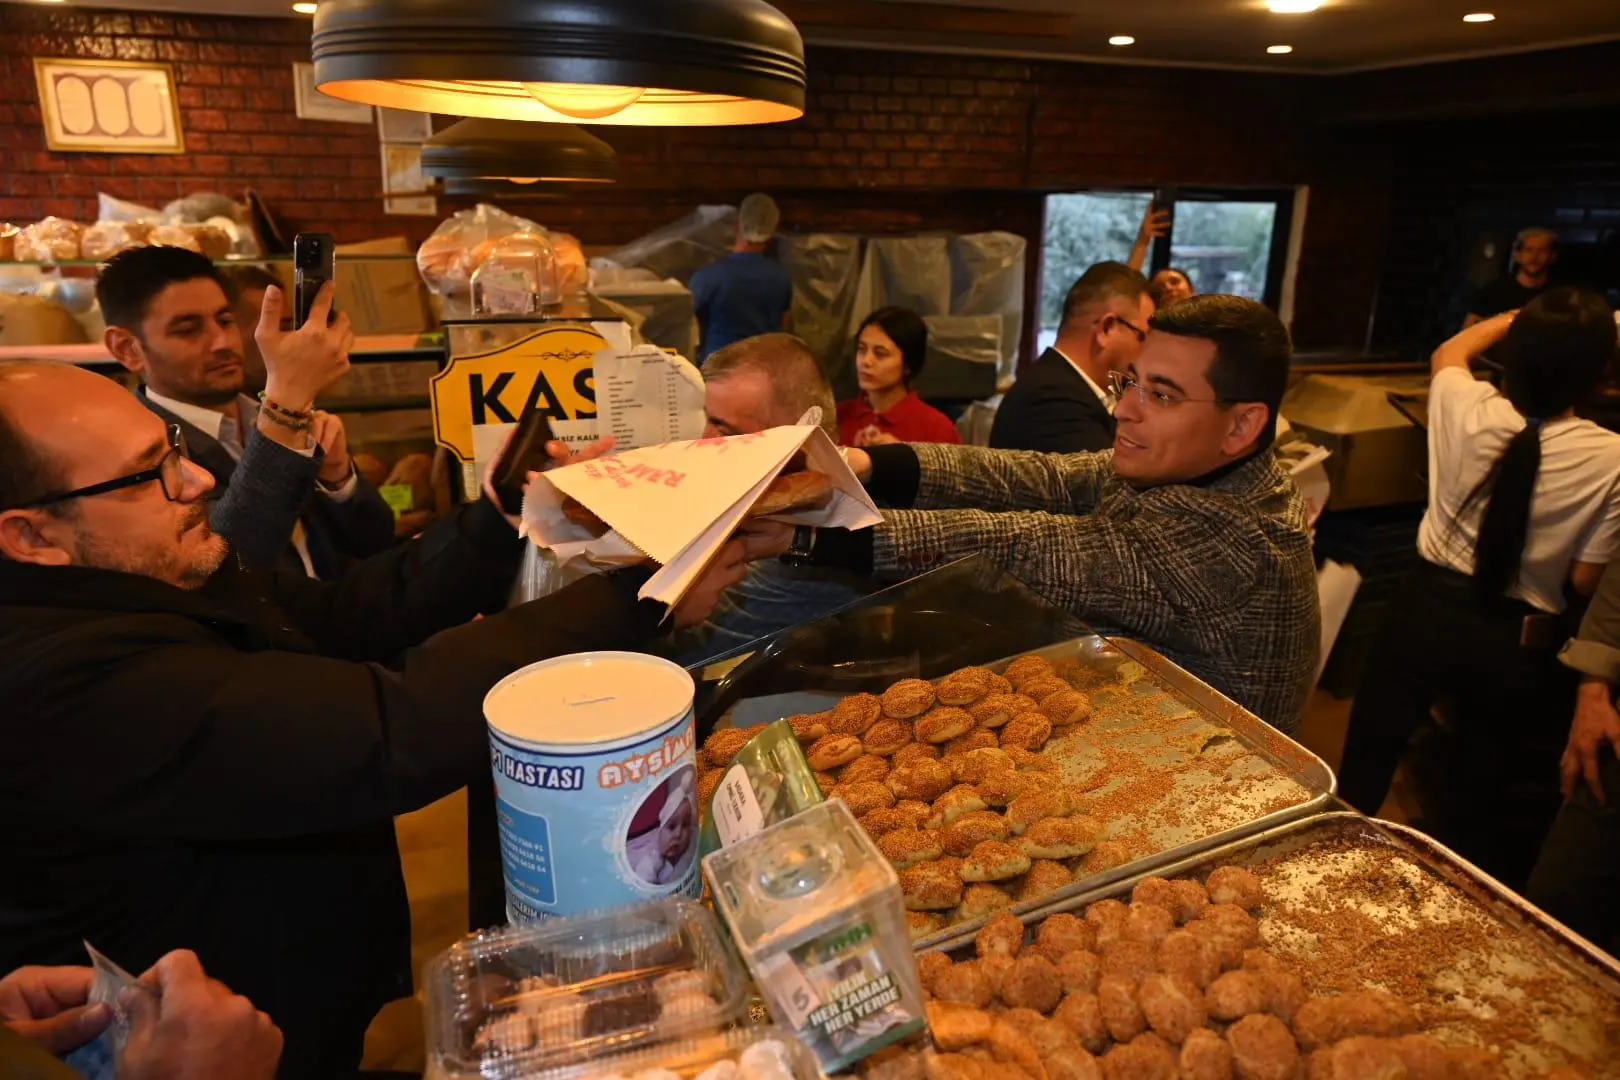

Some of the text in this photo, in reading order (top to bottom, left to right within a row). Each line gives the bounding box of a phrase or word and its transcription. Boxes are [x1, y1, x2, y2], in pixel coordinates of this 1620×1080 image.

[504, 754, 584, 790] HASTASI
[809, 974, 892, 1027] HER ZAMAN
[823, 985, 900, 1035] HER YERDE
